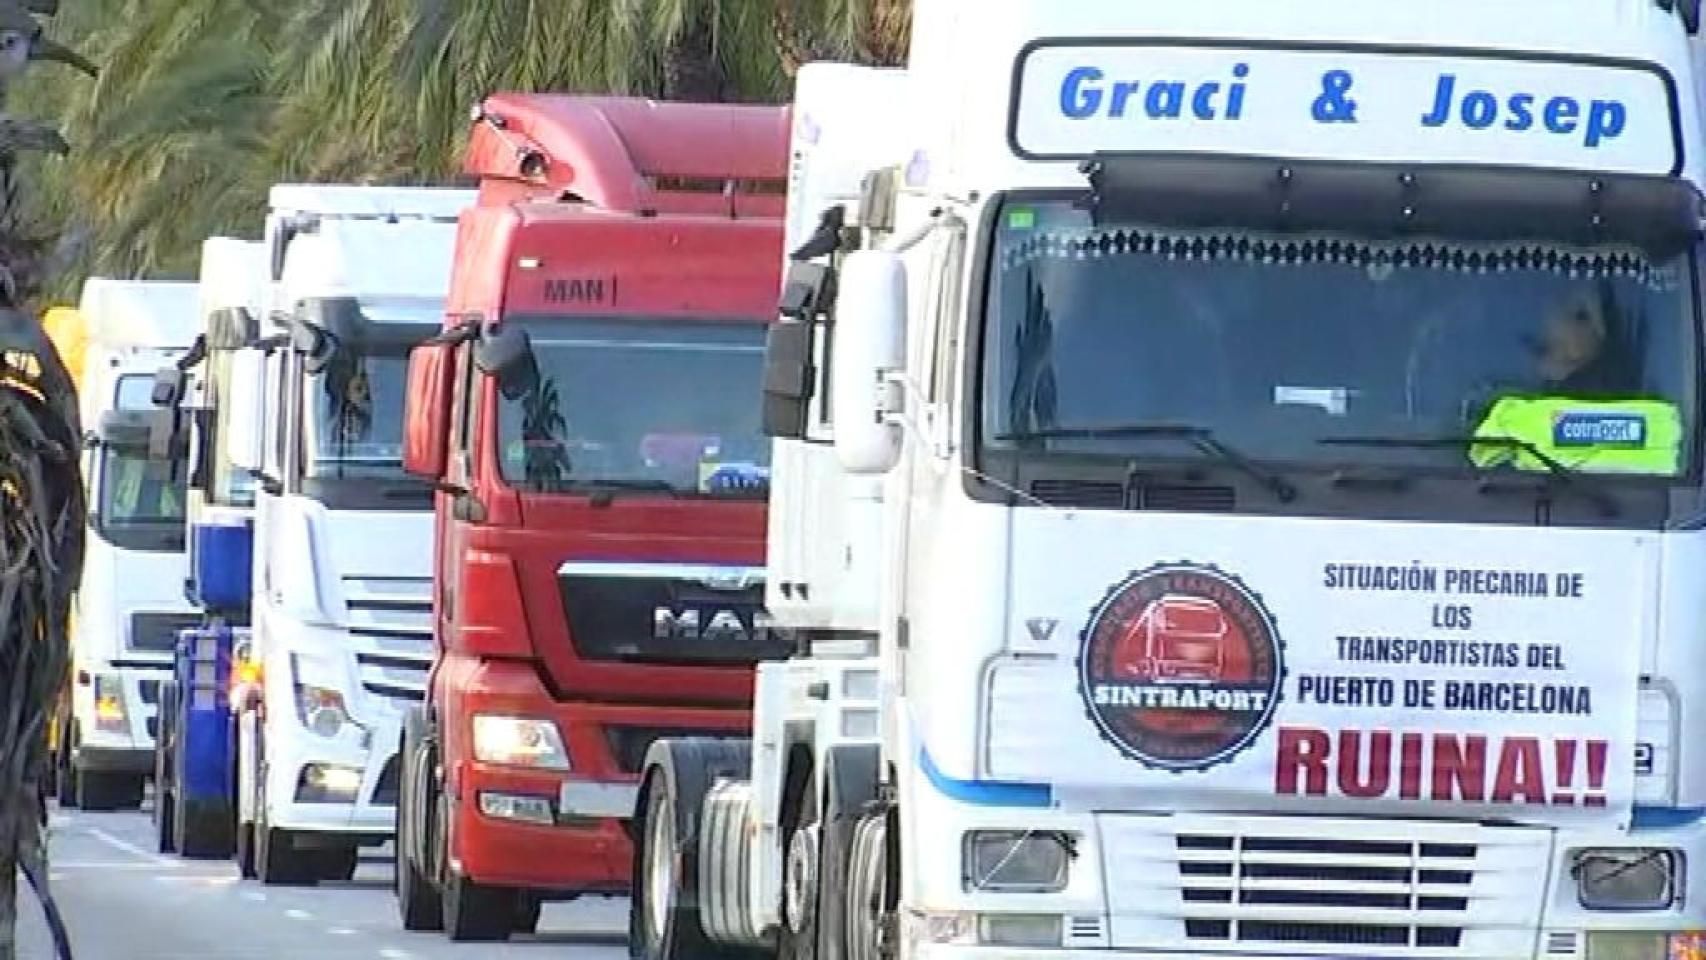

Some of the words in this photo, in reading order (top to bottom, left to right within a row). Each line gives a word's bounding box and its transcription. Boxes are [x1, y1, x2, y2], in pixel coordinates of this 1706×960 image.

[1059, 62, 1250, 121] Graci
[1310, 68, 1359, 123] &
[1421, 73, 1628, 147] Josep
[543, 279, 603, 303] MAN
[1323, 559, 1437, 593] SITUACIÓN
[1443, 569, 1548, 596] PRECARIA
[1555, 573, 1584, 598] DE
[1432, 604, 1472, 630] LOS
[1335, 636, 1520, 668] TRANSPORTISTAS
[1526, 644, 1565, 670] DEL
[1094, 684, 1267, 711] SINTRAPORT
[1298, 675, 1394, 706] PUERTO
[1403, 679, 1436, 710] DE
[1443, 682, 1592, 716] BARCELONA
[1273, 726, 1609, 808] RUINA!!
